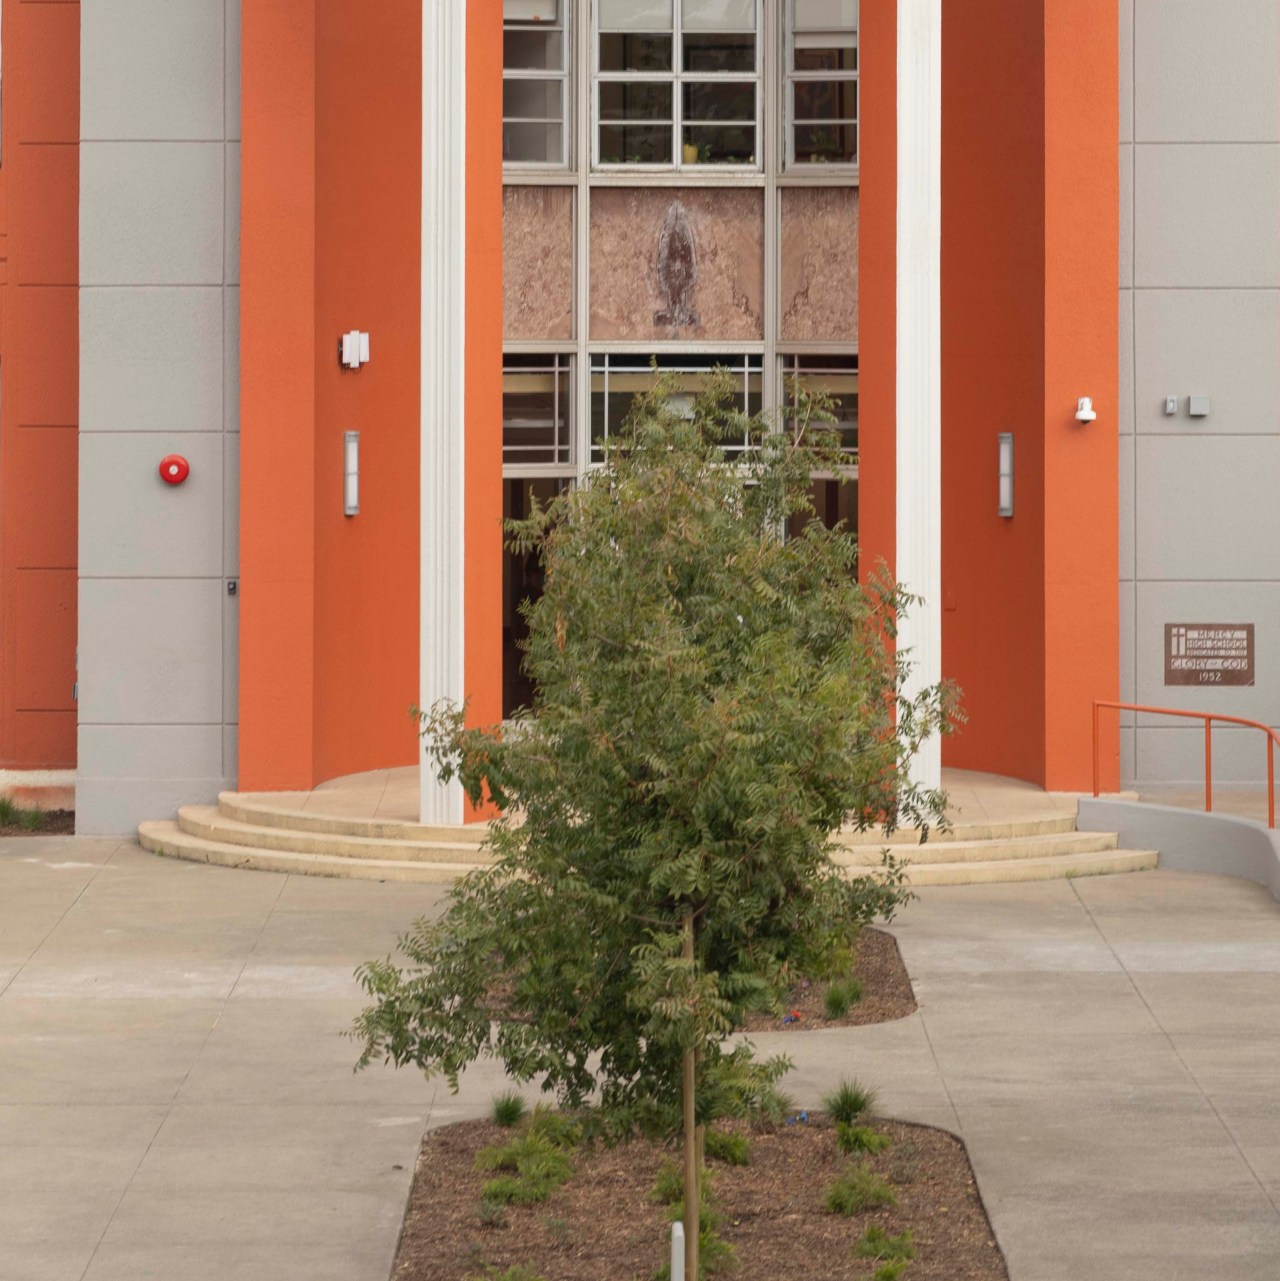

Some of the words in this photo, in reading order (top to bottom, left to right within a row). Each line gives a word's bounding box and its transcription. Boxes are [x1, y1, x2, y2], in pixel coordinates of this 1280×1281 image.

[1198, 629, 1235, 639] MERCY
[1186, 639, 1207, 648] HIGH
[1211, 639, 1248, 648] SCHOOL
[1186, 649, 1221, 657] DEDICATED
[1235, 649, 1248, 657] THE
[1172, 658, 1209, 670] GLORY
[1222, 658, 1248, 670] GOD
[1199, 672, 1222, 682] 1952
